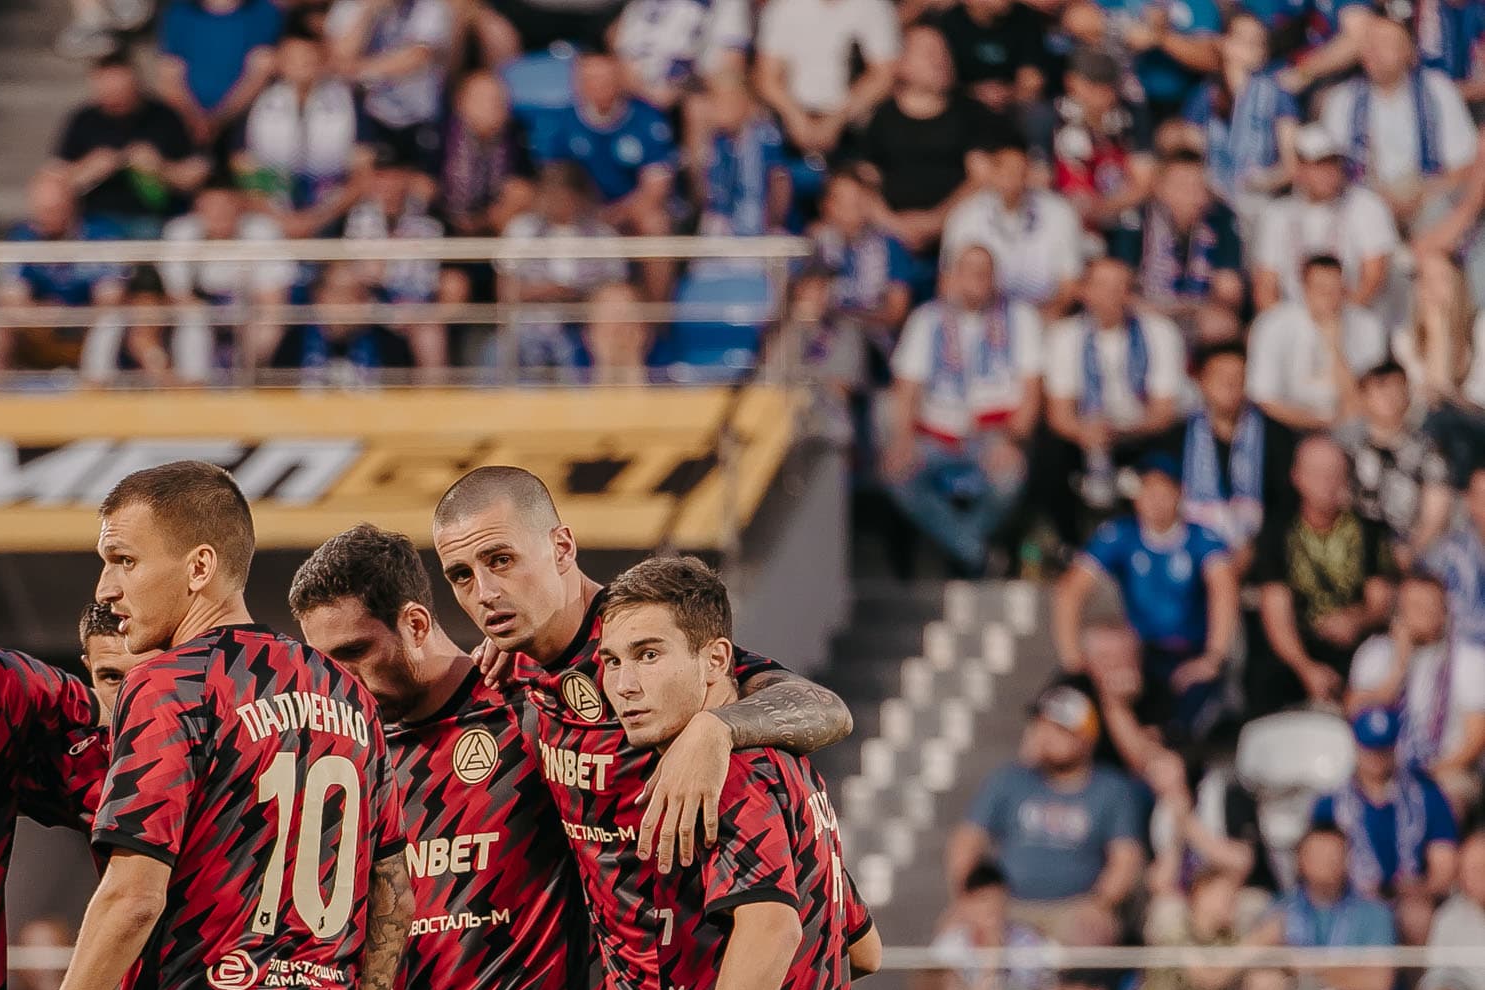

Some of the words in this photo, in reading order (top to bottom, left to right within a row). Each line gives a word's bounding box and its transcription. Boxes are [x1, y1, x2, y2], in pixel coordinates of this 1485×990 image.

[235, 691, 369, 748] ПАЛИЕНКО
[538, 738, 614, 791] ONBET
[250, 751, 361, 938] 10
[408, 907, 510, 938] ВОСТАЛЬ-М
